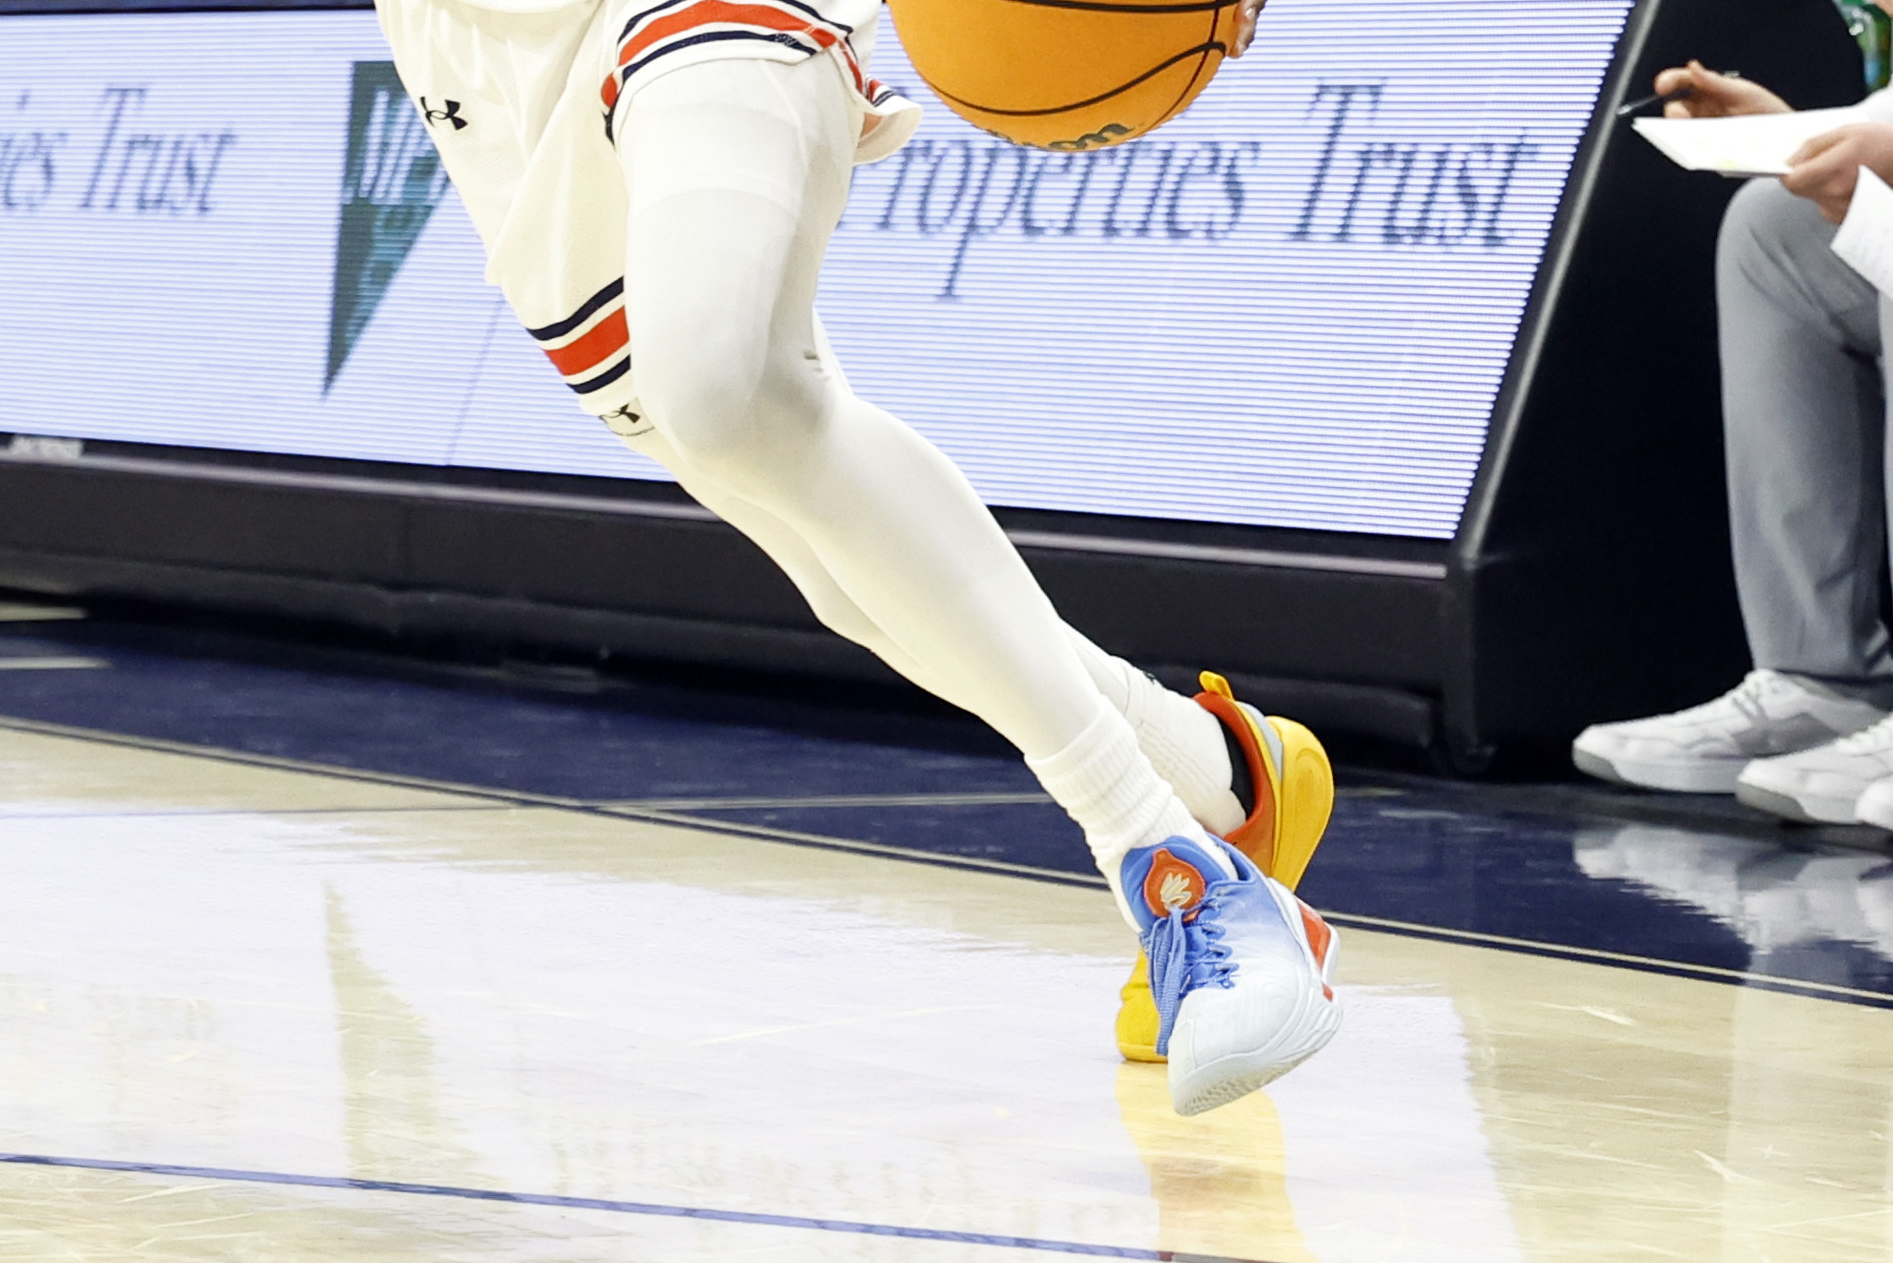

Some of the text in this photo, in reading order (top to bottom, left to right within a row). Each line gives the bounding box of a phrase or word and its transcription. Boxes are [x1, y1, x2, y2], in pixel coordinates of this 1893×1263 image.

[76, 83, 240, 216] Trust
[838, 75, 1540, 303] roperties Trust
